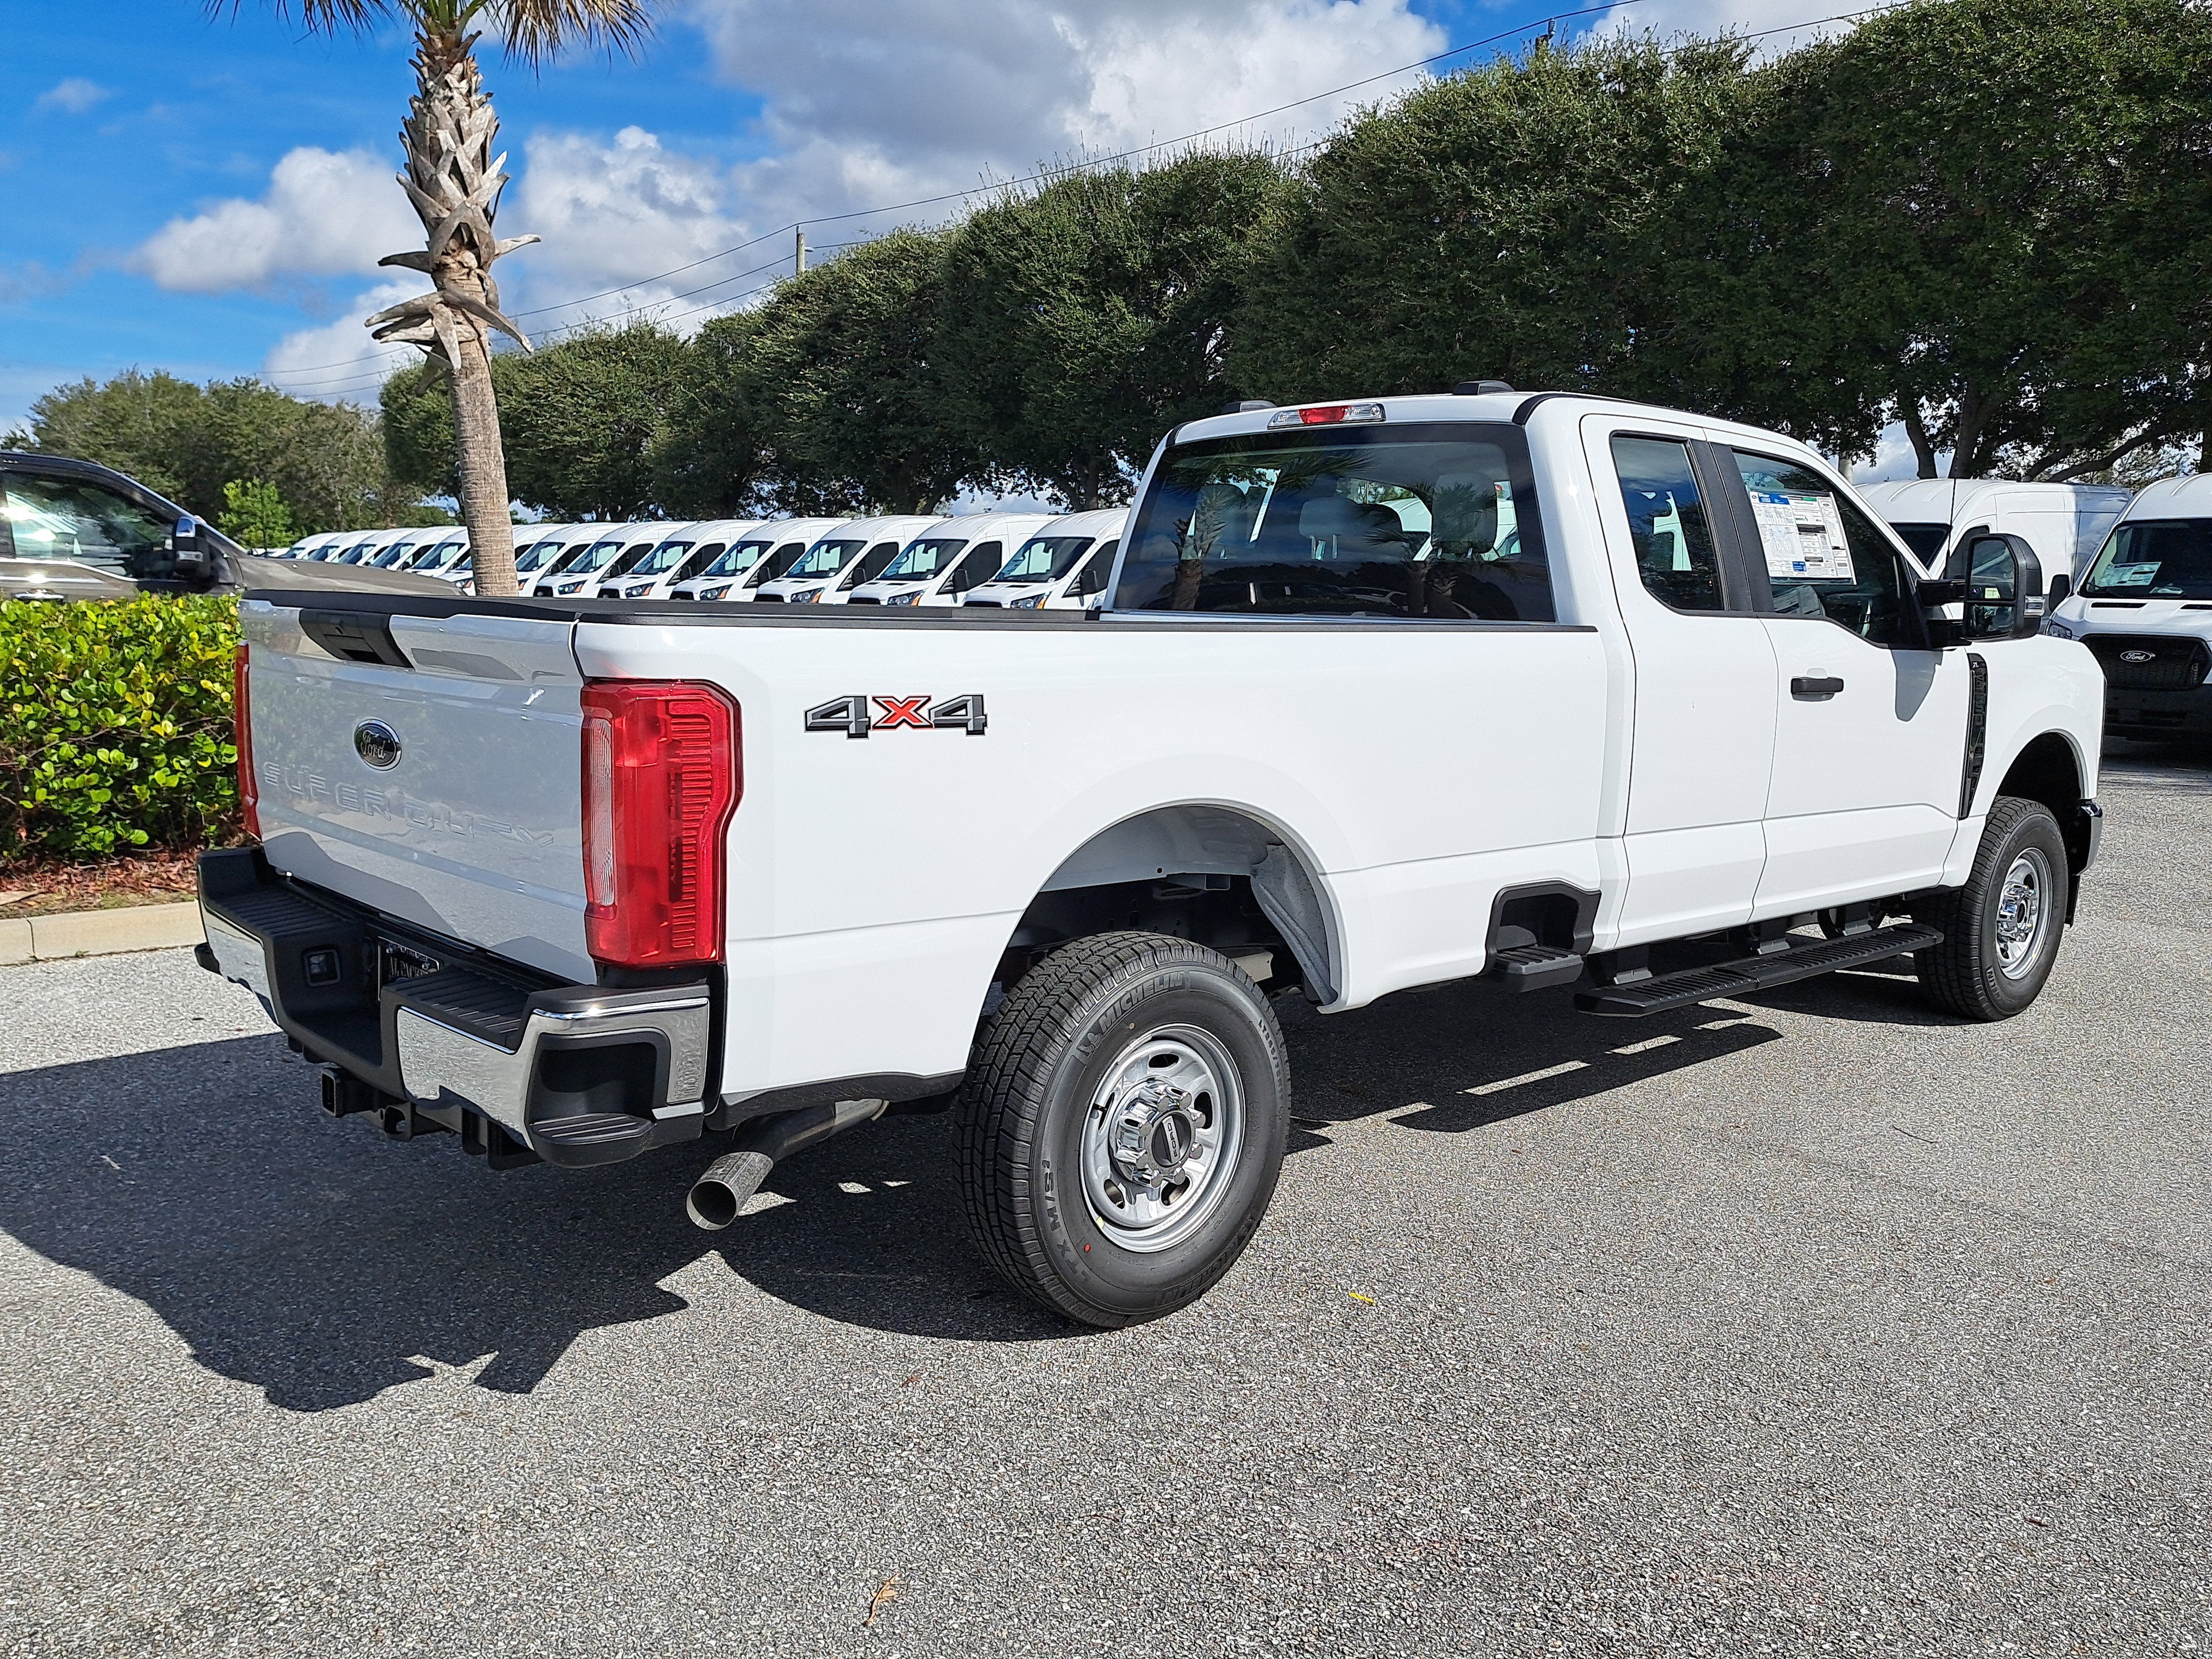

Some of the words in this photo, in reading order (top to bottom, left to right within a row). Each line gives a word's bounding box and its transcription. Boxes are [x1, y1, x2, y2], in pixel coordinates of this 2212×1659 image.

[804, 693, 988, 740] 4X4
[360, 729, 387, 760] Ford
[264, 761, 391, 821] SUPER
[1099, 971, 1185, 1033] MICHELIN
[1167, 1122, 1178, 1157] FORD
[1057, 1239, 1092, 1284] LTX
